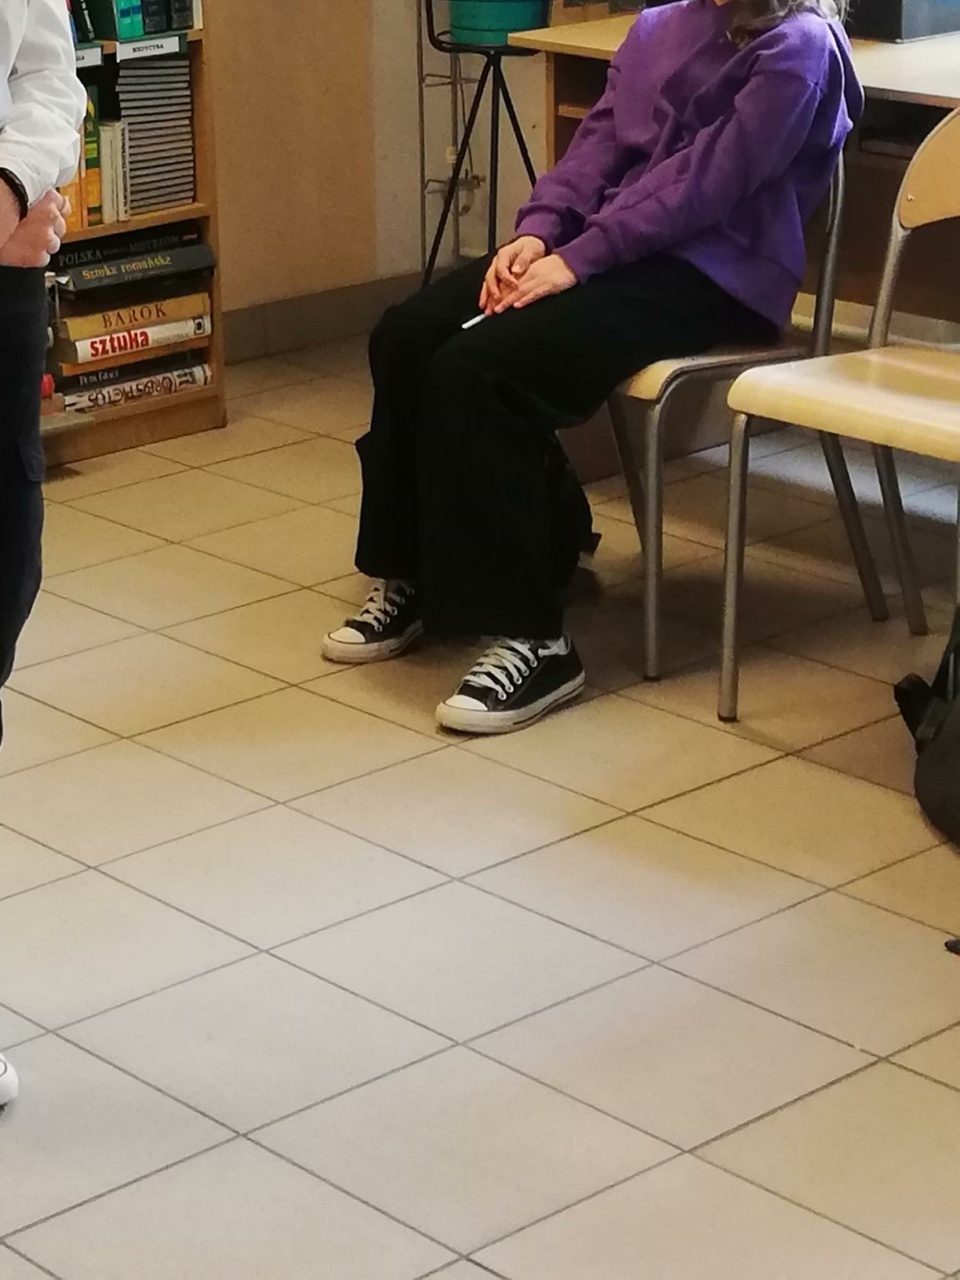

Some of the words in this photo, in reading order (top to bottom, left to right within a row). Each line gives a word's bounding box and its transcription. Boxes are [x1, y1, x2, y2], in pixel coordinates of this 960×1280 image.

[59, 248, 103, 267] POLSKA
[101, 302, 168, 329] BAROK
[90, 329, 150, 358] sztuka
